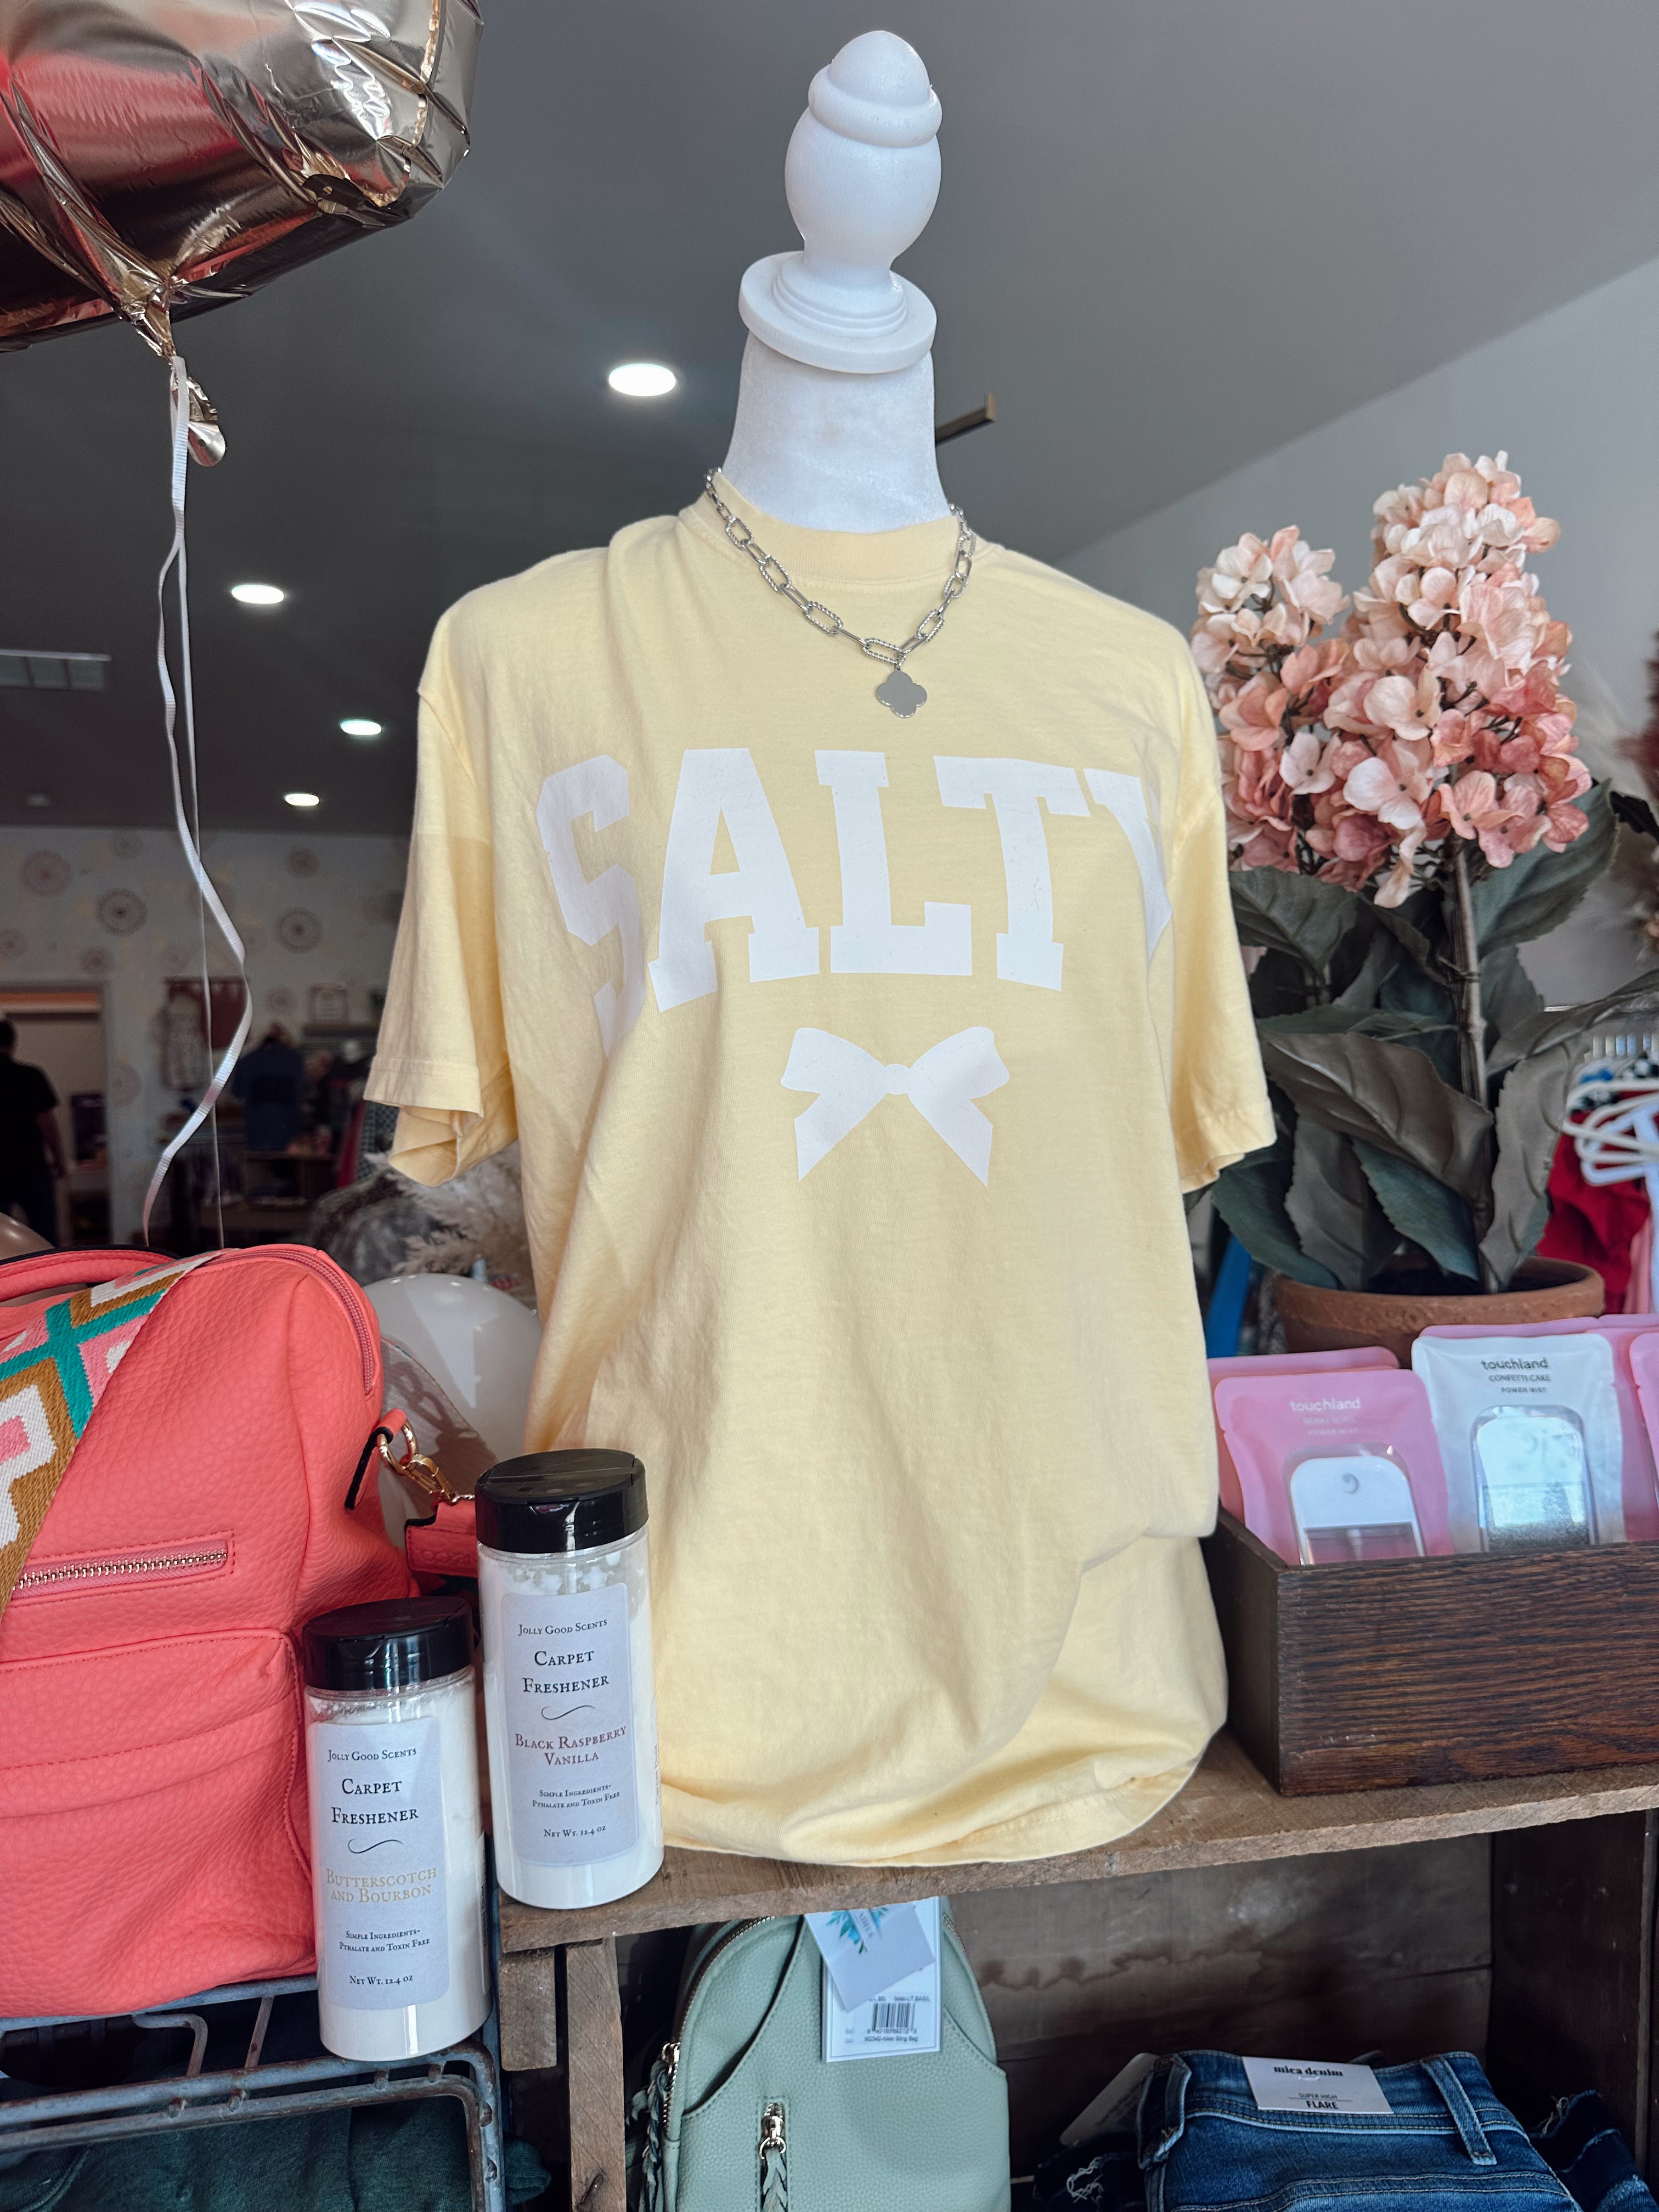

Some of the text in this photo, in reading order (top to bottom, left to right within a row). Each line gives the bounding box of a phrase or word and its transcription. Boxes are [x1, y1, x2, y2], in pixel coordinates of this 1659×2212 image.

[536, 747, 1173, 1058] SALTY
[1481, 1357, 1548, 1370] touchland
[1530, 1374, 1551, 1382] CAKE
[1290, 1396, 1361, 1412] touchland
[518, 1620, 607, 1636] JOLLY GOOD SCENTS
[534, 1650, 594, 1666] CARPET
[522, 1675, 610, 1693] FRESHENER
[515, 1726, 627, 1749] BLACK RASPBERRY
[328, 1748, 417, 1762] JOLLY GOOD SCENTS
[544, 1752, 599, 1765] VANILLA
[342, 1778, 403, 1794] CARPET
[331, 1807, 419, 1824] FRESHENER
[326, 1867, 437, 1888] BUTTERSCOTCH
[358, 1884, 432, 1903] BOURBON
[1274, 2066, 1343, 2076] mica denim
[1306, 2101, 1339, 2109] FLARE
